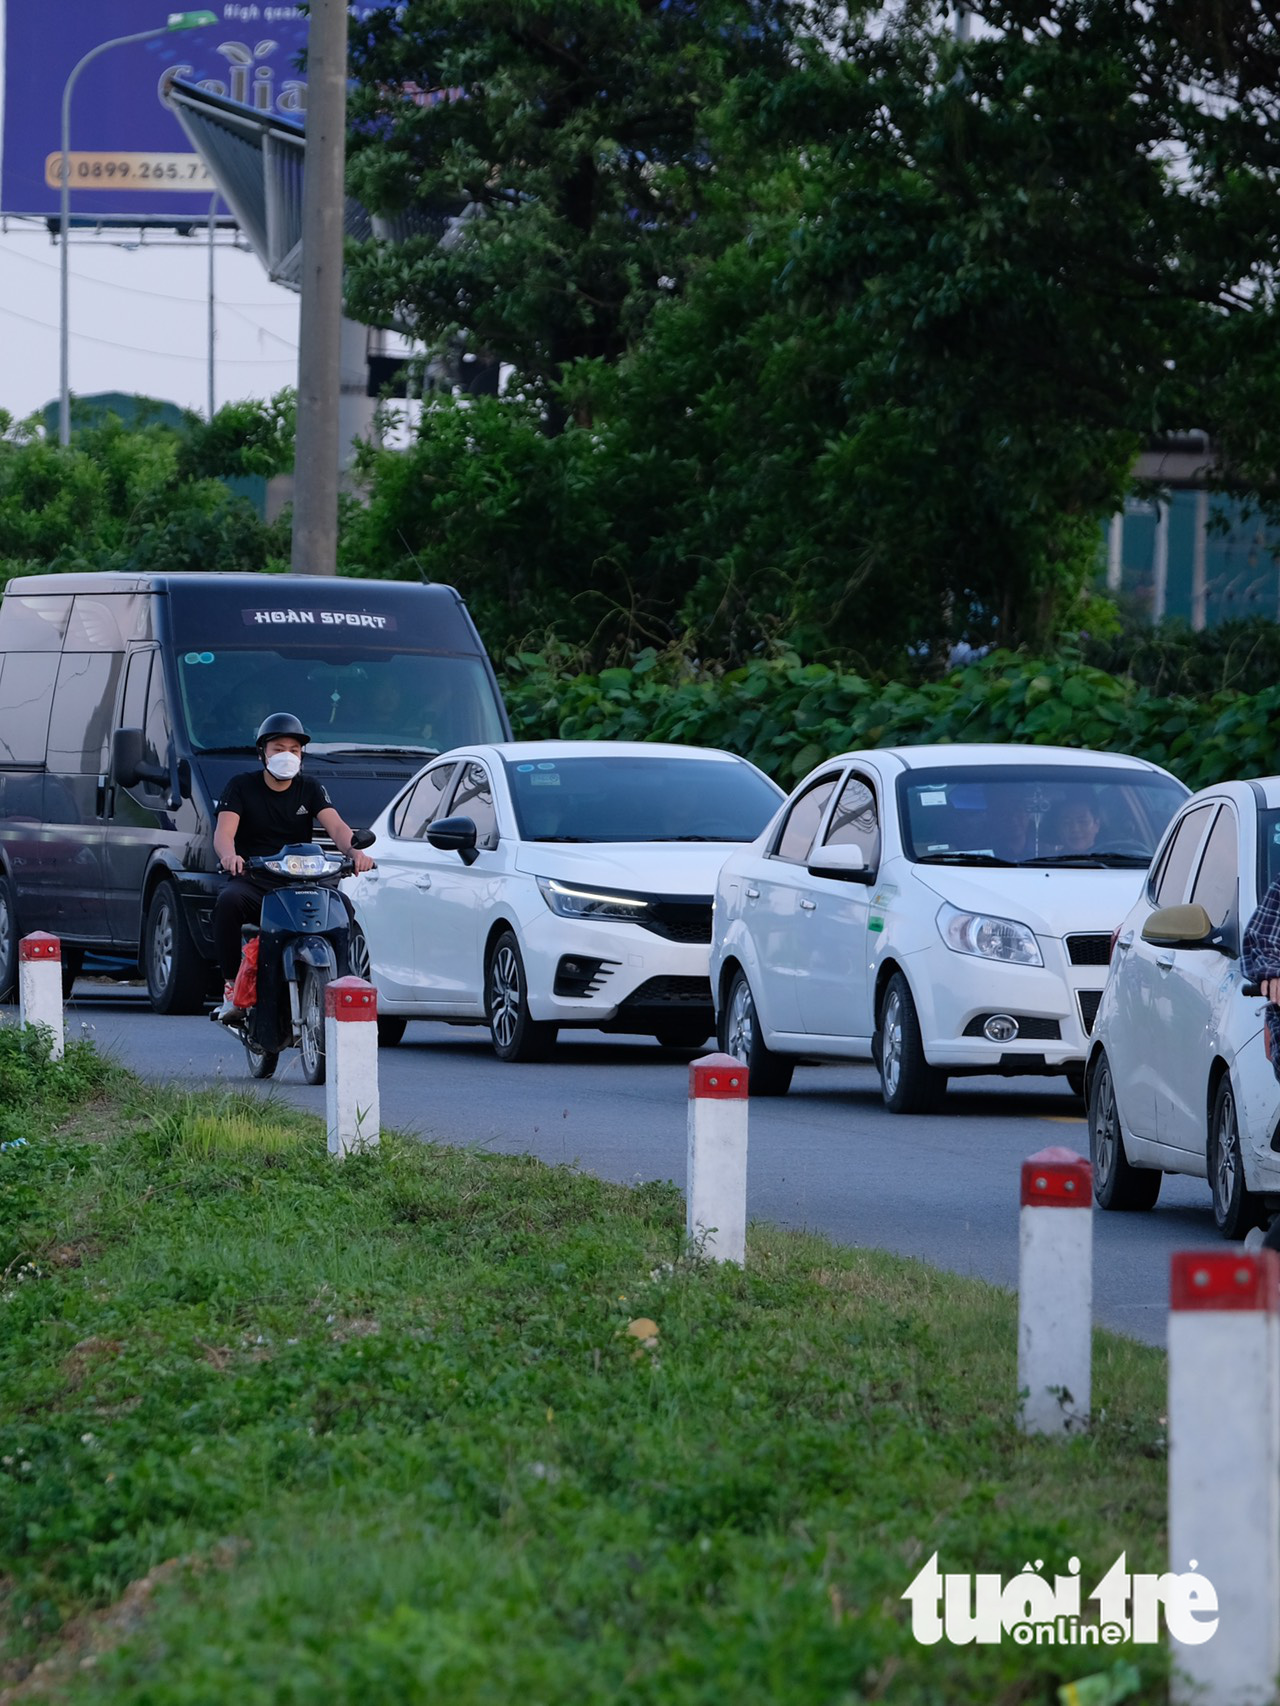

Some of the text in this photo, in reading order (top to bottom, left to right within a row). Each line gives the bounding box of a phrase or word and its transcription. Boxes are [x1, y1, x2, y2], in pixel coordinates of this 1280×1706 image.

[224, 3, 259, 23] High
[77, 161, 210, 179] 0899.265.77
[254, 609, 386, 629] HOÀN SPORT
